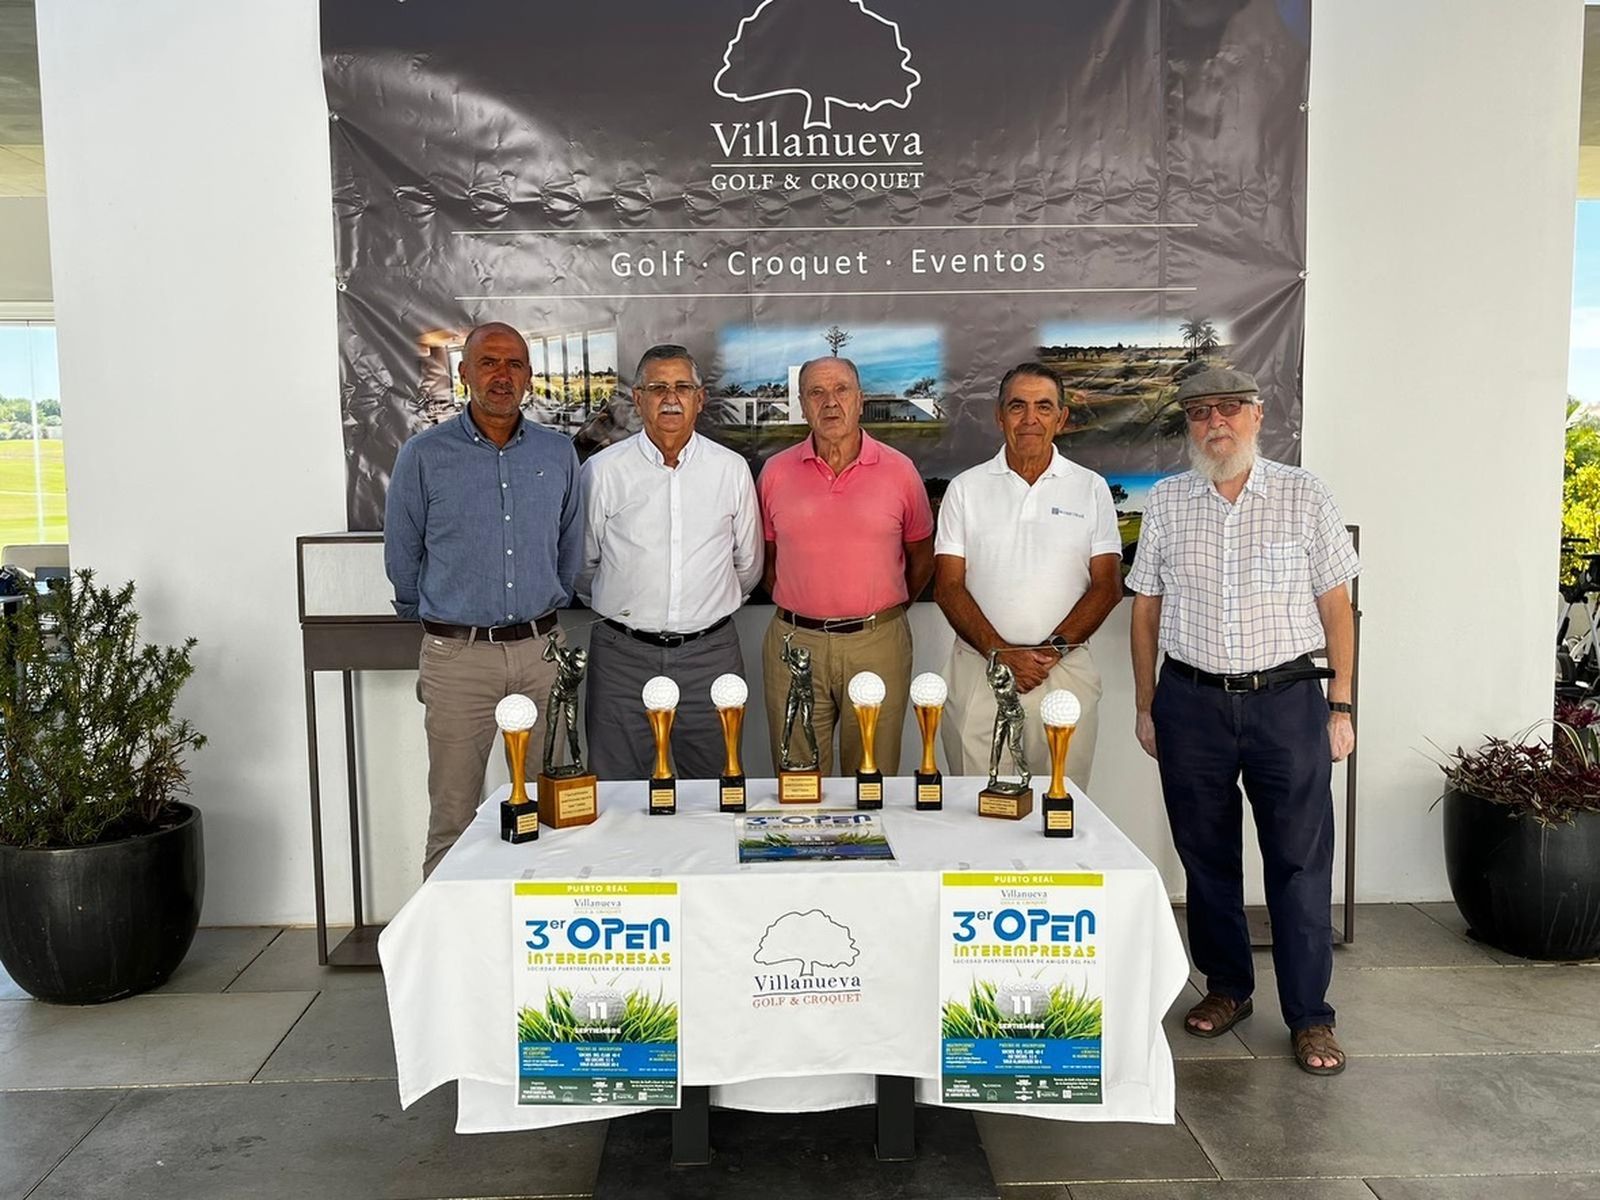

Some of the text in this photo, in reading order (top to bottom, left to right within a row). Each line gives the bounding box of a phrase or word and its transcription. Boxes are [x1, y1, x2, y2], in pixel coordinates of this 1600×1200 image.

[710, 120, 924, 158] Villanueva
[711, 172, 924, 192] GOLF & CROQUET
[611, 249, 1046, 281] Golf Croquet Eventos
[993, 875, 1054, 884] PUERTO REAL
[567, 885, 629, 893] PUERTO REAL
[1000, 889, 1048, 898] Villanueva
[574, 898, 622, 908] Villanueva
[566, 917, 671, 951] OPEN
[993, 908, 1096, 943] OPEN
[527, 951, 671, 965] INTEREMPRESAS
[953, 943, 1096, 958] INTEREMPRESAS
[754, 974, 861, 991] Villanueva
[752, 993, 862, 1009] GOLF & CROQUET
[1011, 995, 1032, 1014] 11
[586, 1001, 608, 1020] 11
